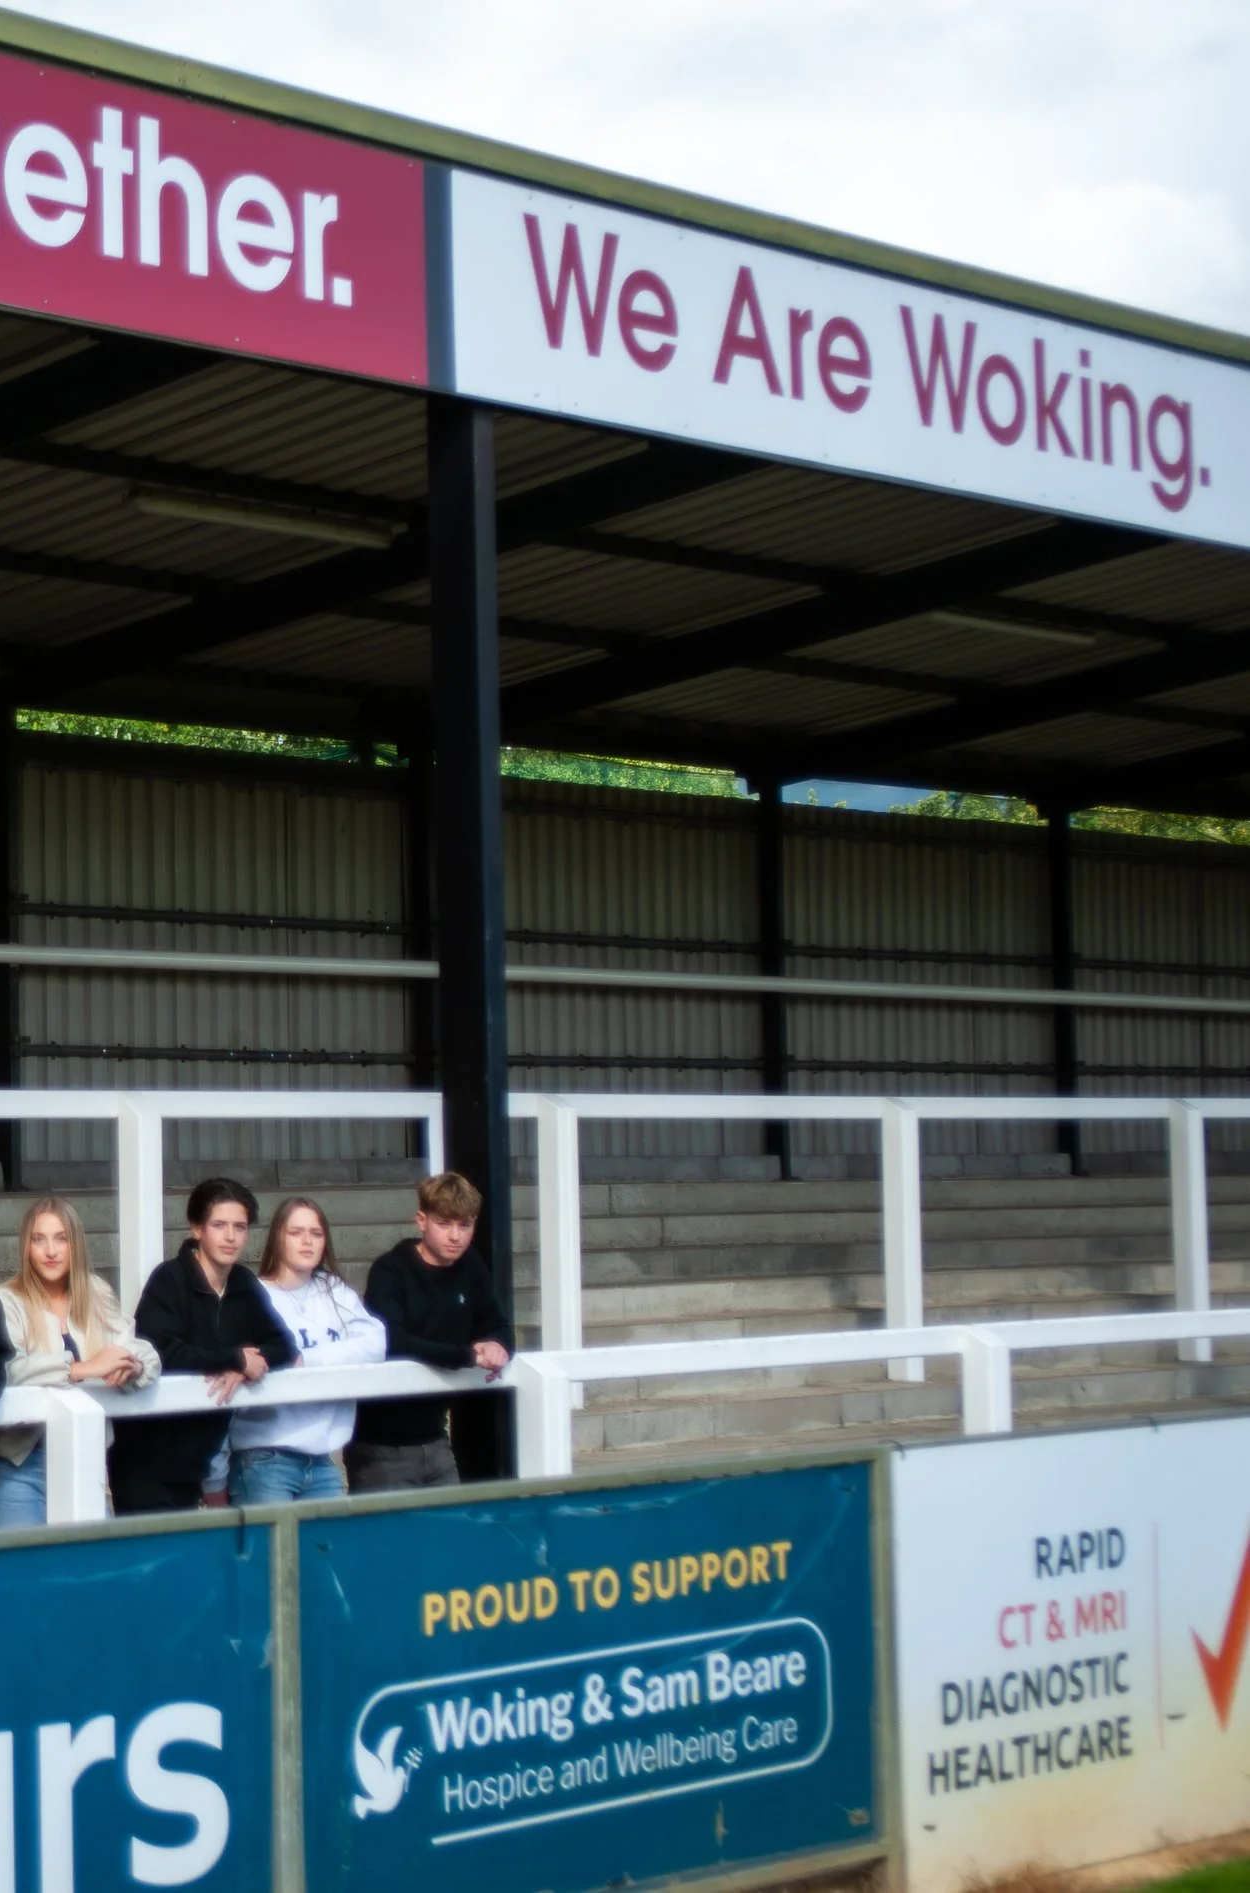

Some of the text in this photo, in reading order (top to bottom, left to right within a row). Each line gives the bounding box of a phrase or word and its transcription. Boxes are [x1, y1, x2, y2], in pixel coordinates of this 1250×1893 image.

[523, 213, 1212, 512] We Are Woking.
[423, 1541, 793, 1637] PROUD TO SUPPORT
[1035, 1527, 1126, 1579] RAPID
[998, 1590, 1128, 1650] CT & MRI
[426, 1651, 807, 1753] Woking & Sam Beare
[941, 1652, 1130, 1727] DIAGNOSTIC
[444, 1713, 798, 1813] Hospice and Wellbeing Care
[928, 1715, 1133, 1796] HEALTHCARE
